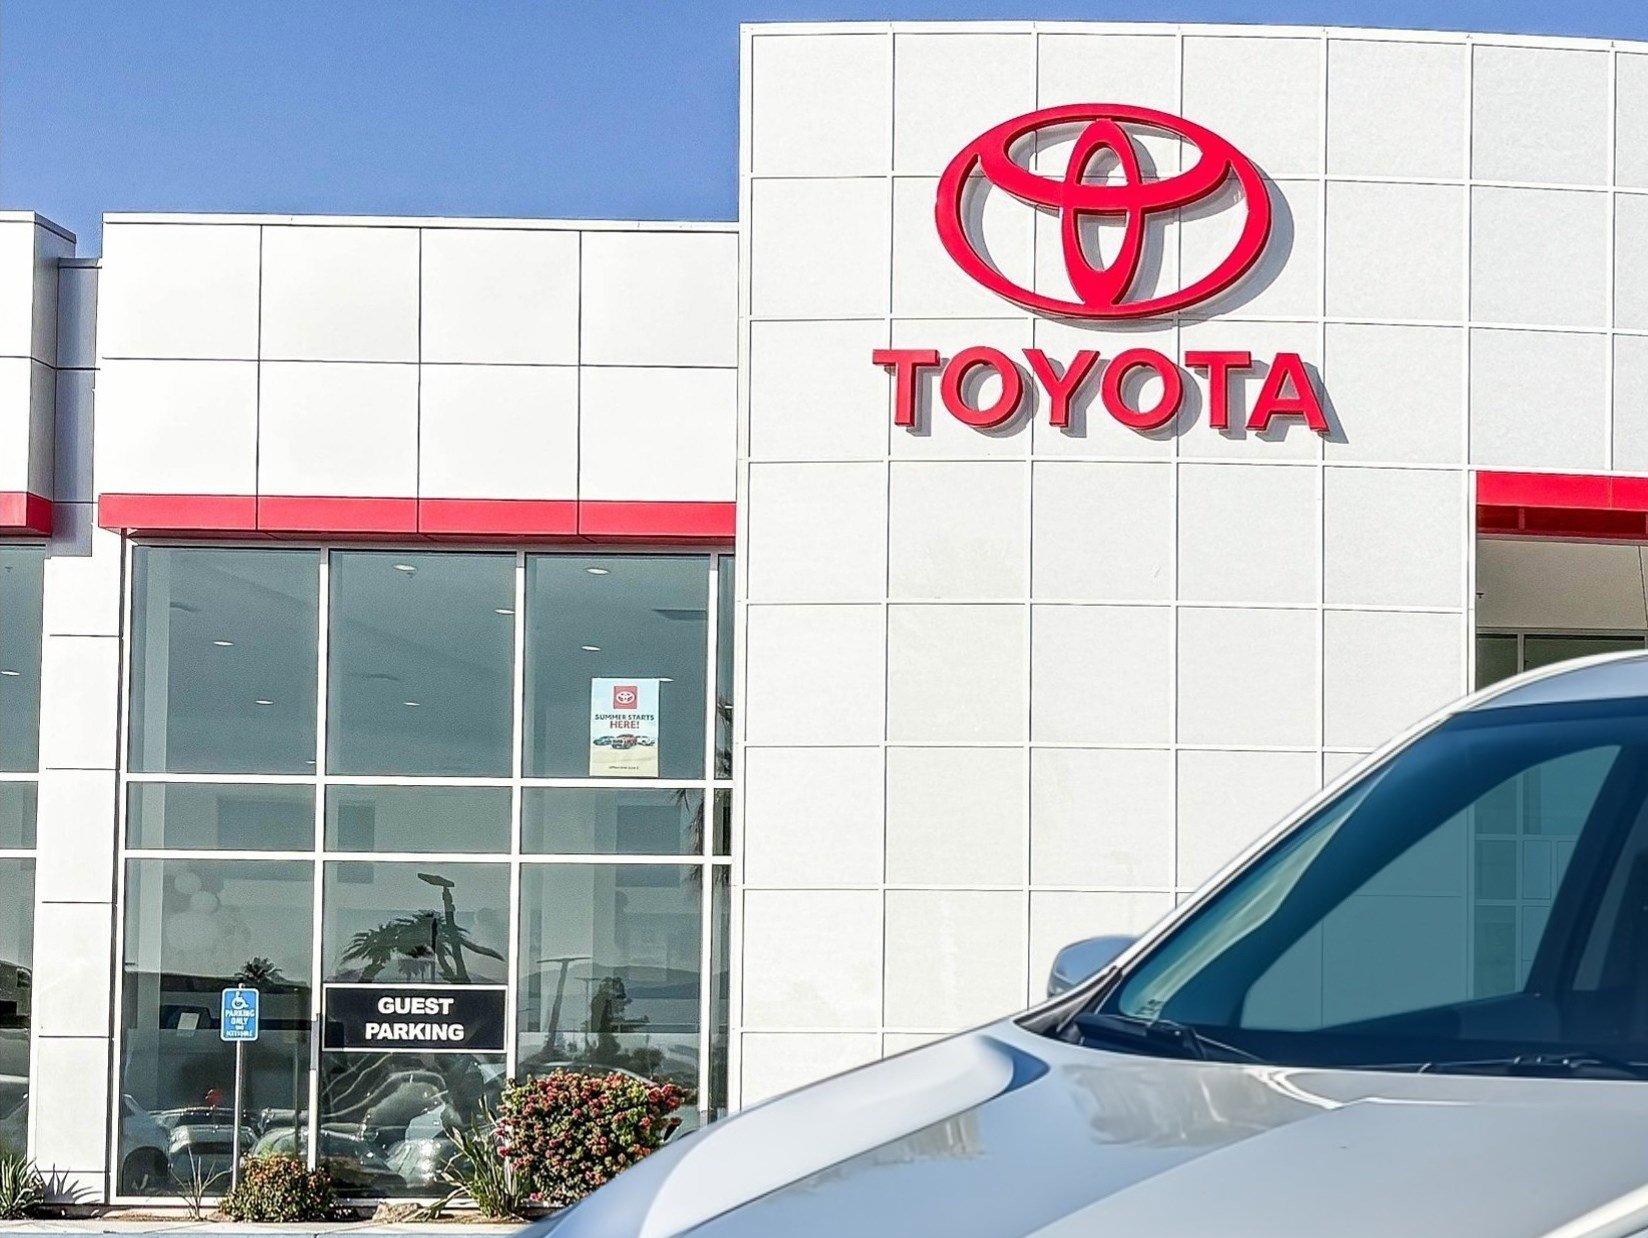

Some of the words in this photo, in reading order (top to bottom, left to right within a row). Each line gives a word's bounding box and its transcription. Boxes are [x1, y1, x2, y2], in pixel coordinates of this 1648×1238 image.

[872, 346, 1330, 433] TOYOTA
[609, 721, 640, 729] HERE!
[377, 997, 454, 1015] GUEST
[225, 1009, 255, 1017] PARKING
[230, 1017, 249, 1025] ONLY
[365, 1022, 465, 1041] PARKING
